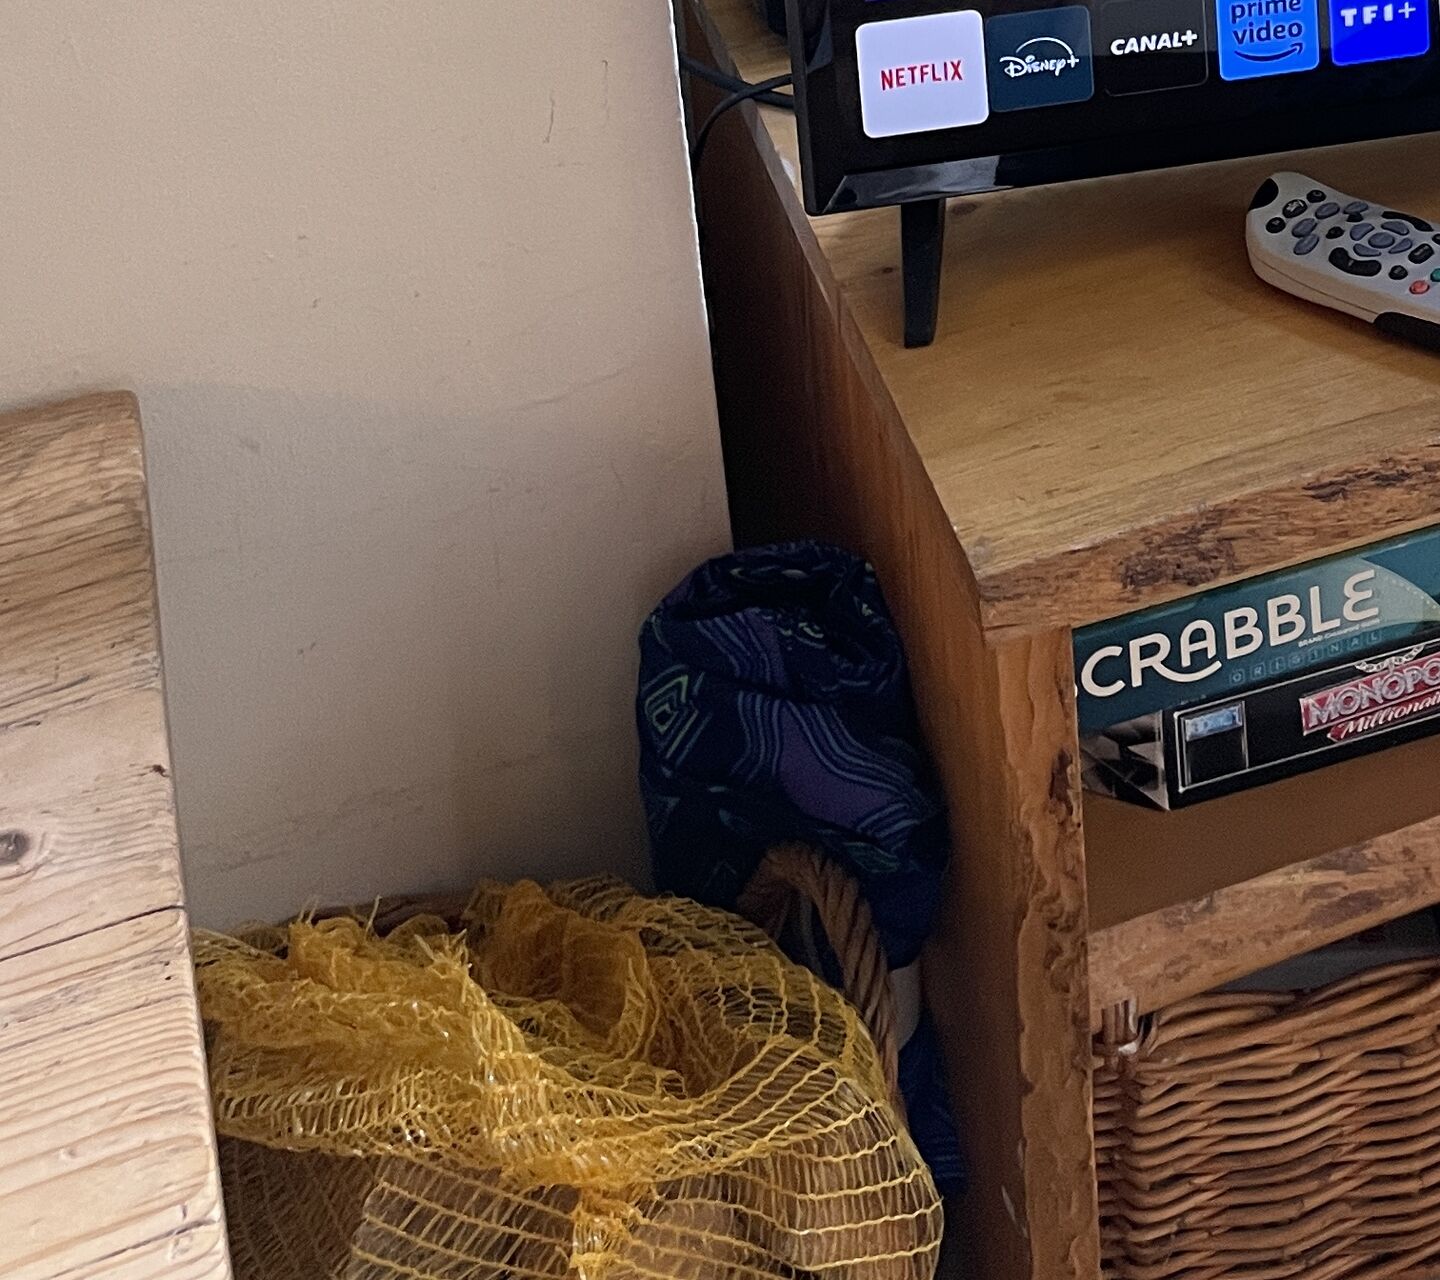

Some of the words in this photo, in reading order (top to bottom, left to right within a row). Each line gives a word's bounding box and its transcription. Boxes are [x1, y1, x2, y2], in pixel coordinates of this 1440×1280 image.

[1110, 29, 1198, 56] CANAL+
[1232, 16, 1303, 46] video
[880, 60, 963, 92] NETFLIX
[1074, 569, 1382, 698] CRABBLE
